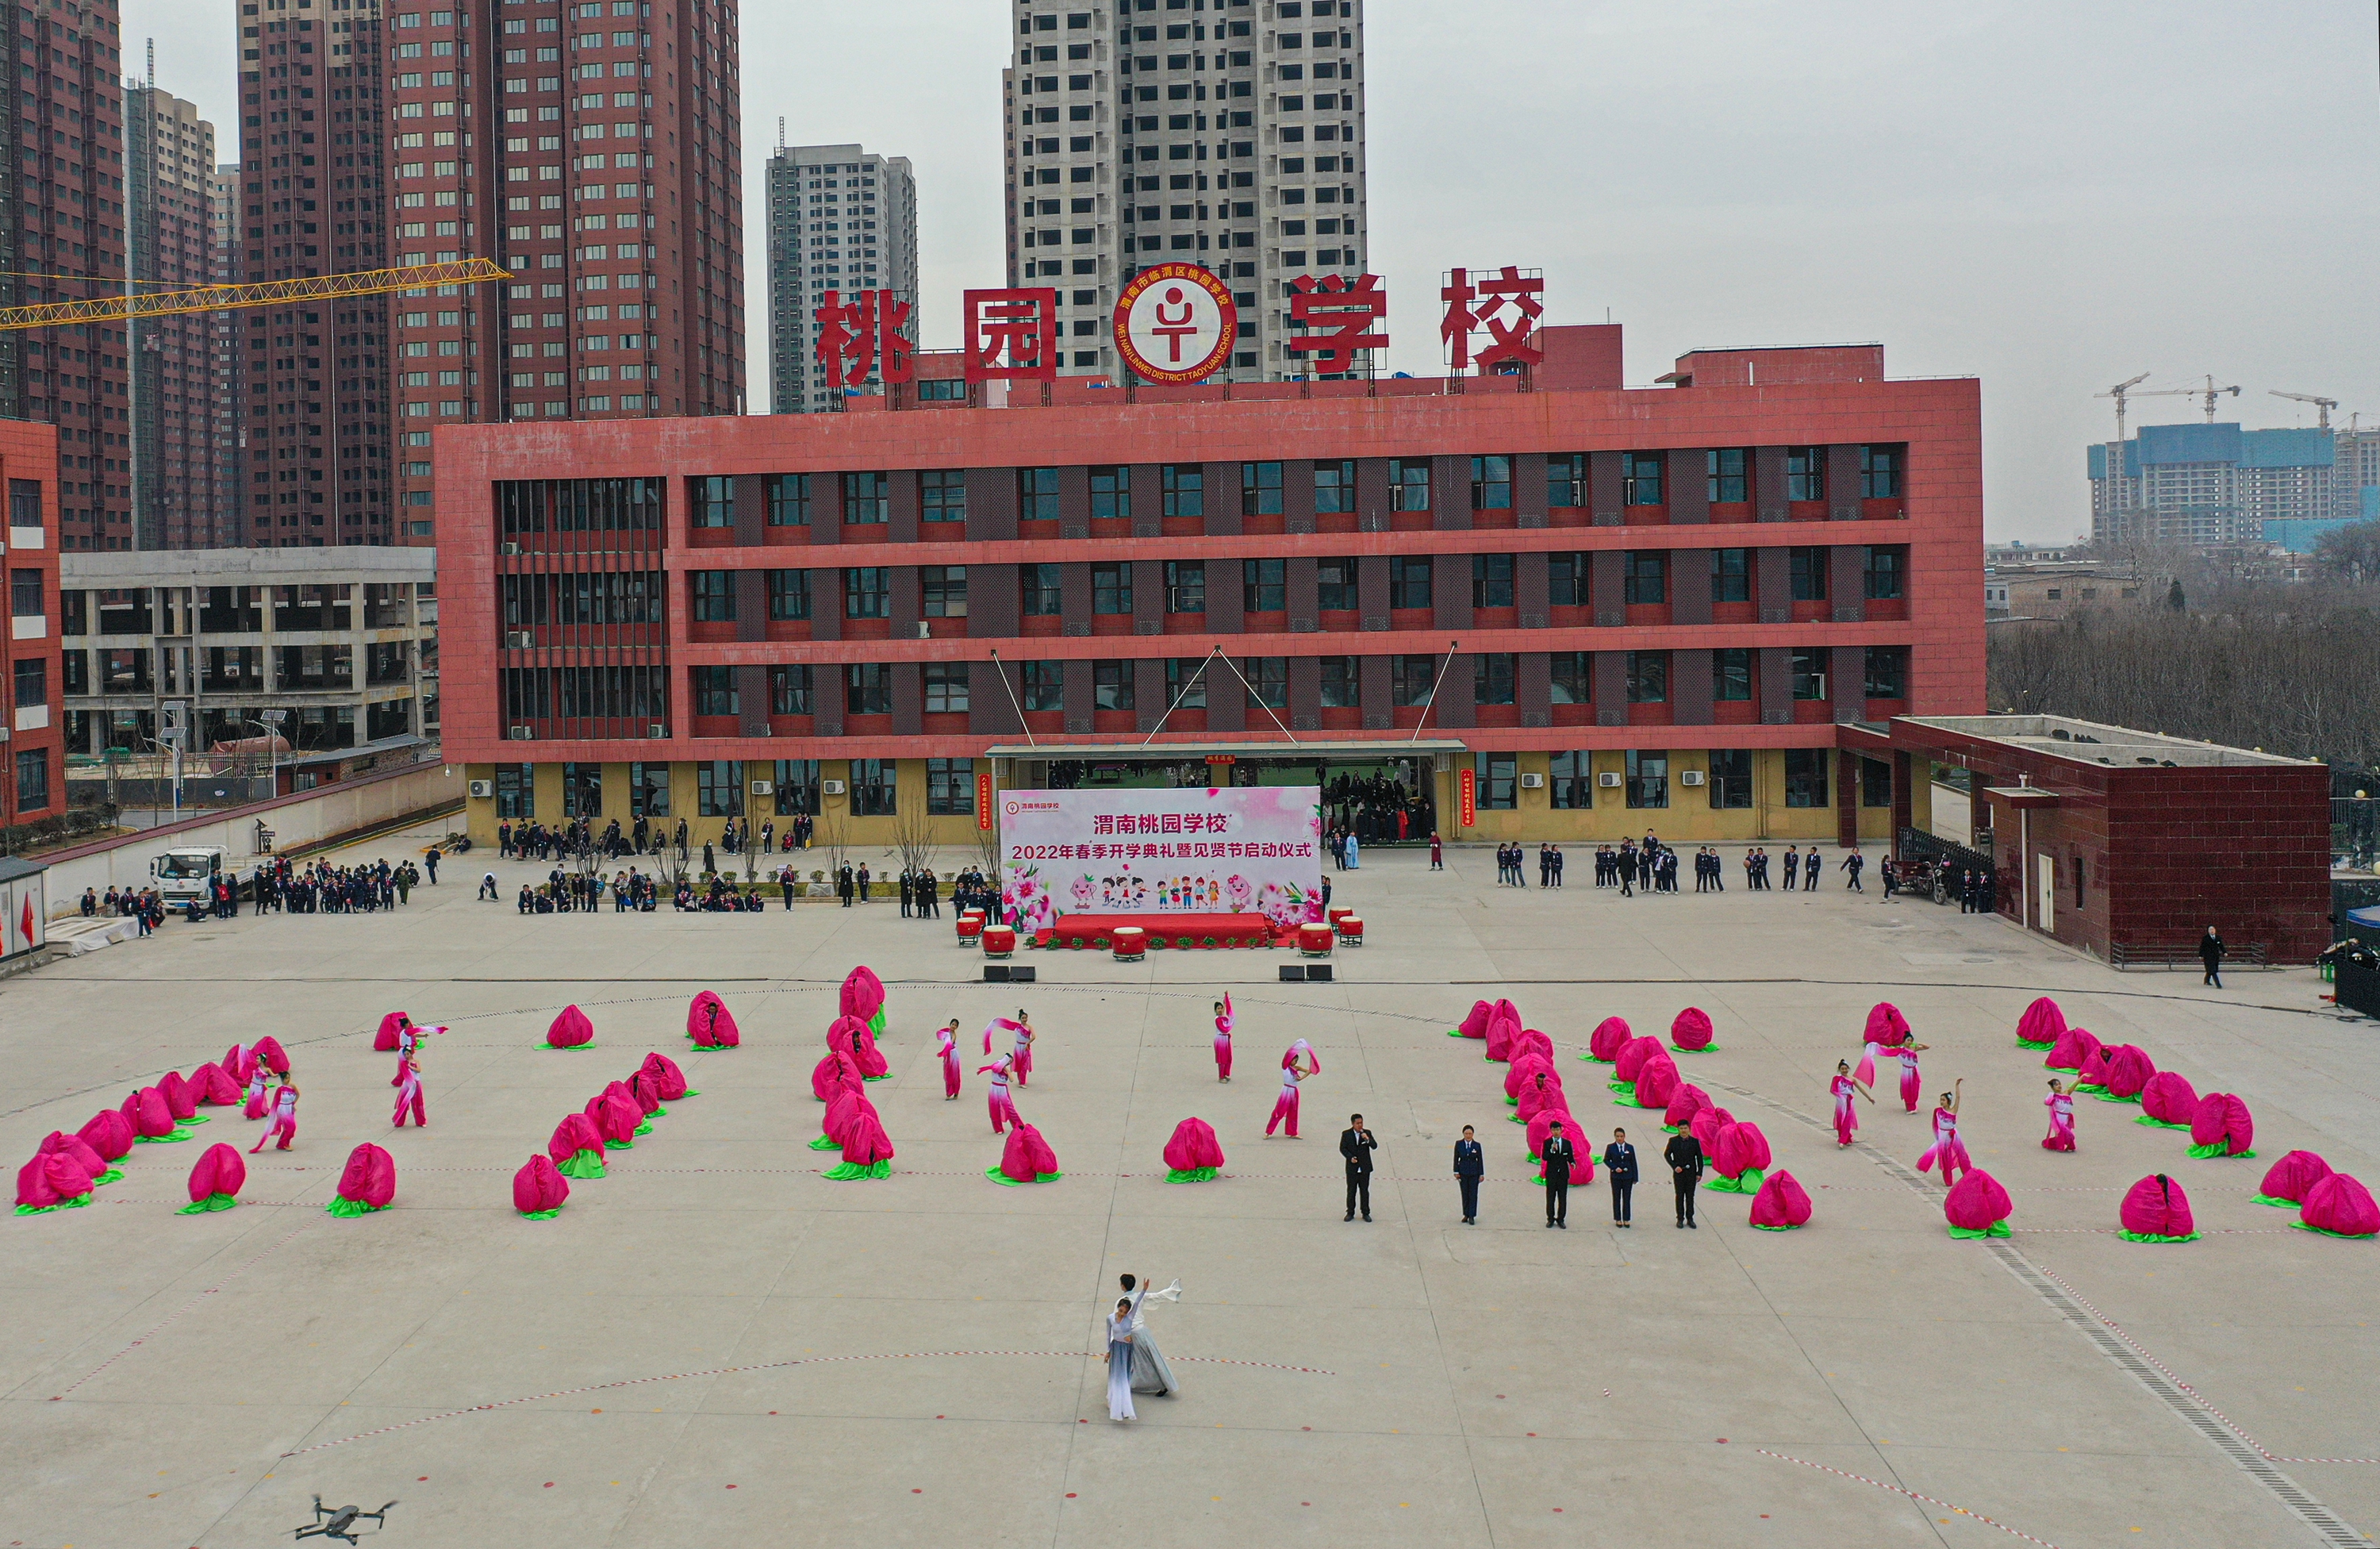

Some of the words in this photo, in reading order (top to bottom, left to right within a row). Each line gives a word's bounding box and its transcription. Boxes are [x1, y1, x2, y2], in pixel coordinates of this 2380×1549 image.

[1120, 266, 1229, 309] 渭南市临渭区桃园学校
[816, 287, 1056, 388] 桃园
[1290, 266, 1545, 374] 学校
[1151, 369, 1187, 382] DISTRICT
[1188, 355, 1222, 379] TAOYUAN
[1217, 322, 1231, 355] SCHOOL
[1093, 813, 1227, 835] 渭南桃园学校
[1012, 841, 1311, 860] 2022年春季开学典礼暨见贤节启动仪式
